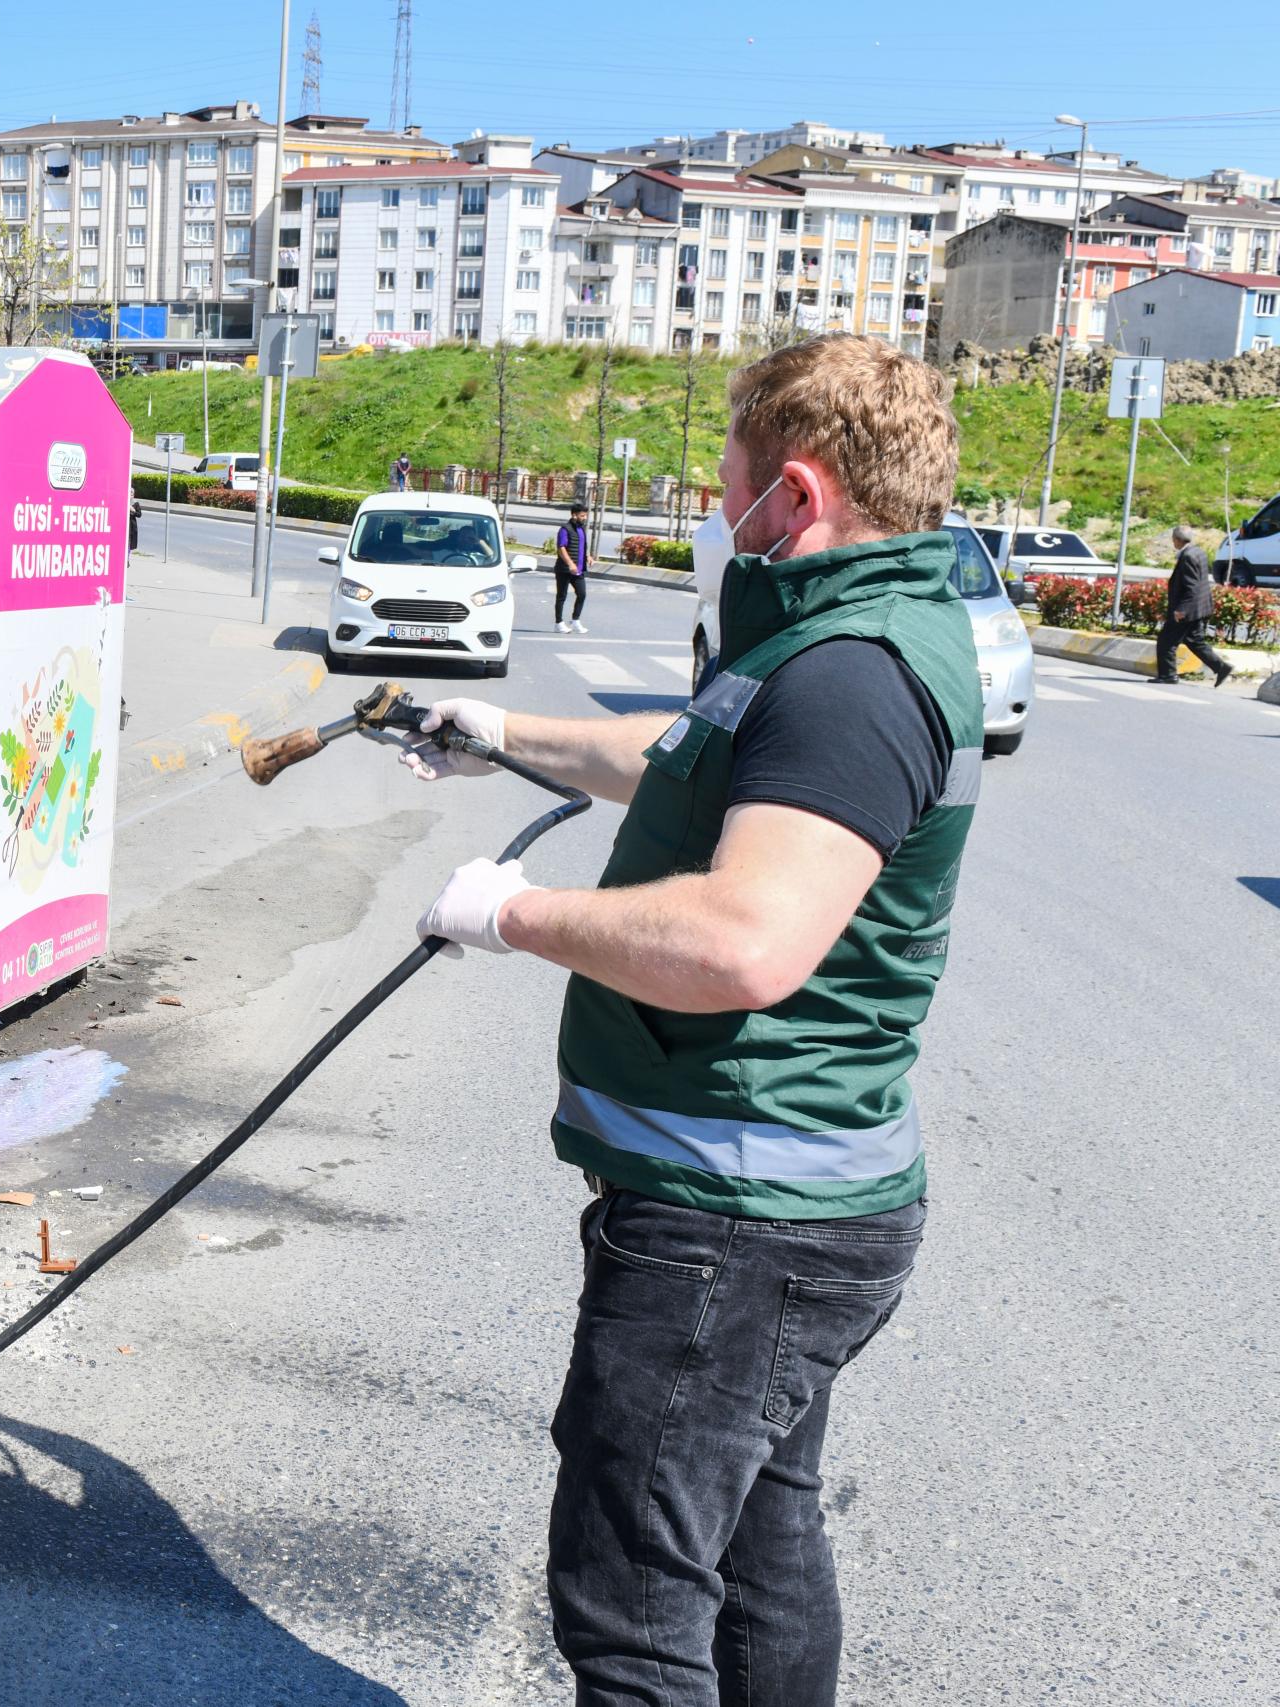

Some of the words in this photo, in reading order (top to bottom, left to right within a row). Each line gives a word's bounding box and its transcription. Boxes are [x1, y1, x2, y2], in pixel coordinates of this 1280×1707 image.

[13, 496, 52, 532] GİYSİ
[62, 499, 111, 533] TEKSTİL
[11, 543, 111, 579] KUMBARASI
[430, 628, 446, 639] 345
[2, 960, 13, 984] 04
[16, 954, 25, 976] 11
